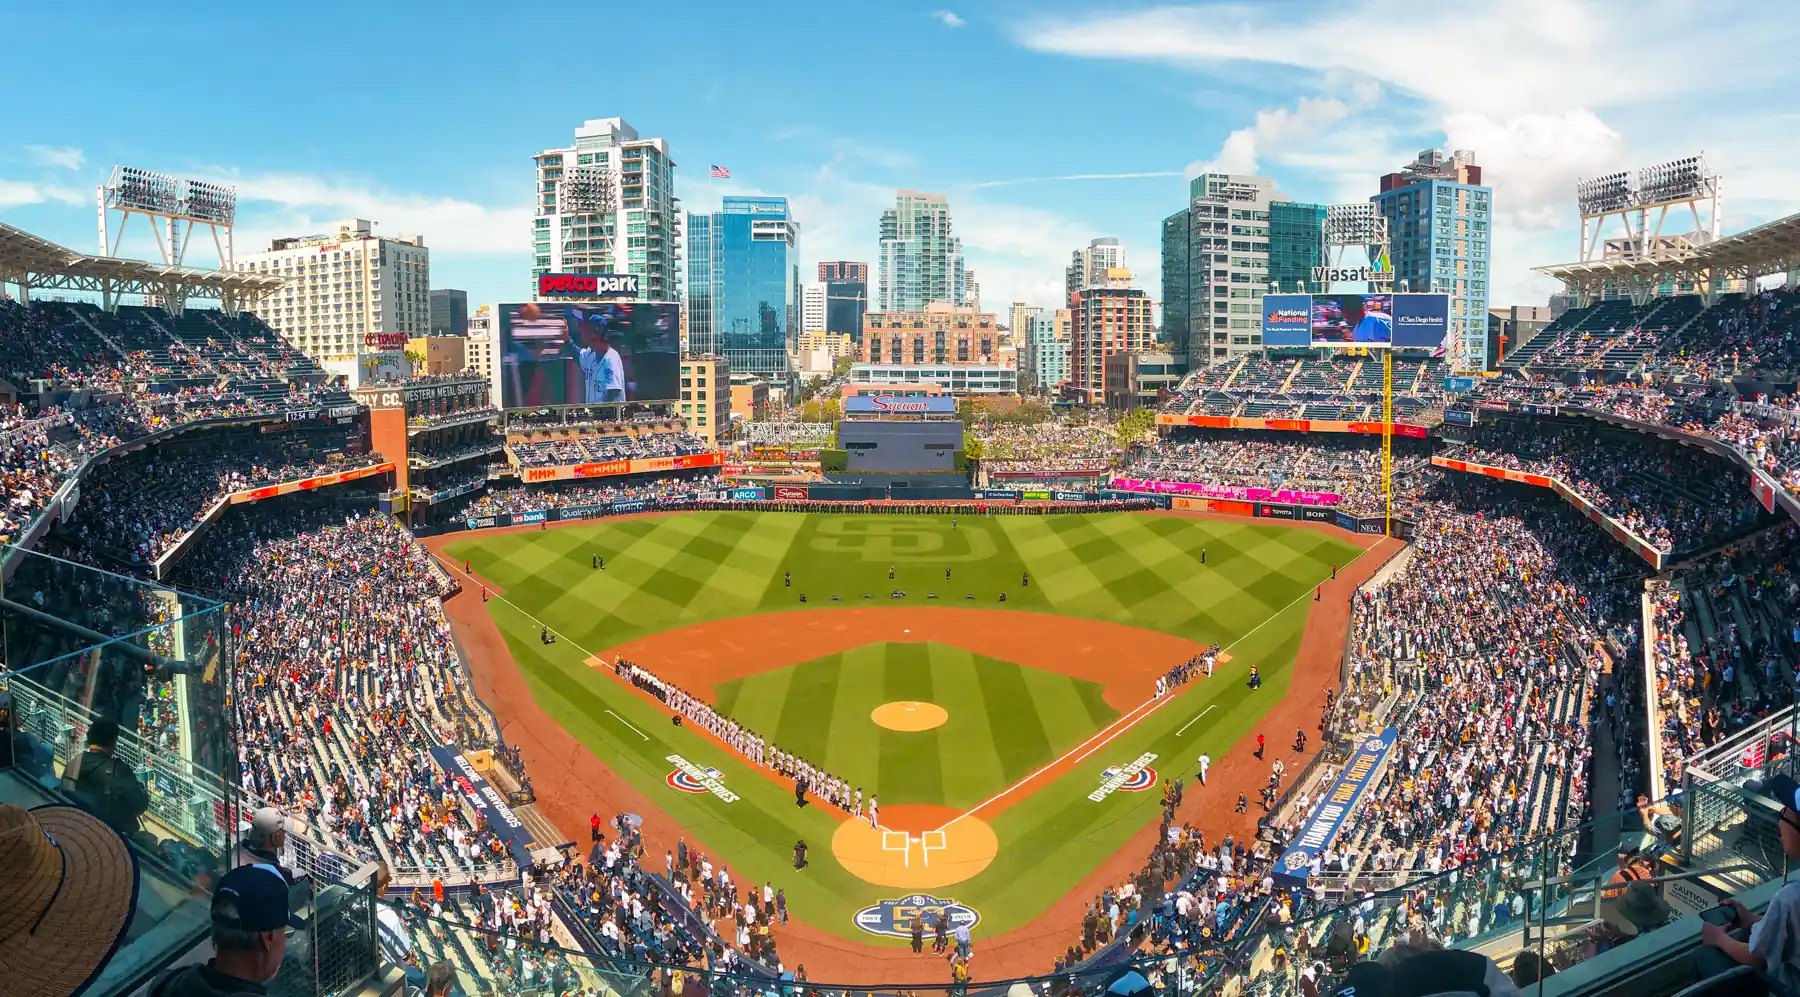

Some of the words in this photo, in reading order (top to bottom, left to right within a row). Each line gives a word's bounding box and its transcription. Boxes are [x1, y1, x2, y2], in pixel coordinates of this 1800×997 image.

[1313, 266, 1368, 281] Viasat
[404, 389, 435, 401] WESTERN
[439, 387, 456, 398] METAL
[458, 384, 477, 395] SUPPLY
[872, 394, 930, 416] Sycuan
[529, 468, 556, 480] MMM
[734, 490, 756, 499] ARCO
[778, 488, 803, 498] Sycuan
[1360, 524, 1382, 533] NECA
[453, 755, 483, 782] WELCOME
[1345, 754, 1379, 782] FAITHFUL
[1330, 783, 1359, 804] FRIAR
[1319, 804, 1344, 823] YOU
[1298, 817, 1335, 848] THANK
[1673, 883, 1709, 908] CAUTION
